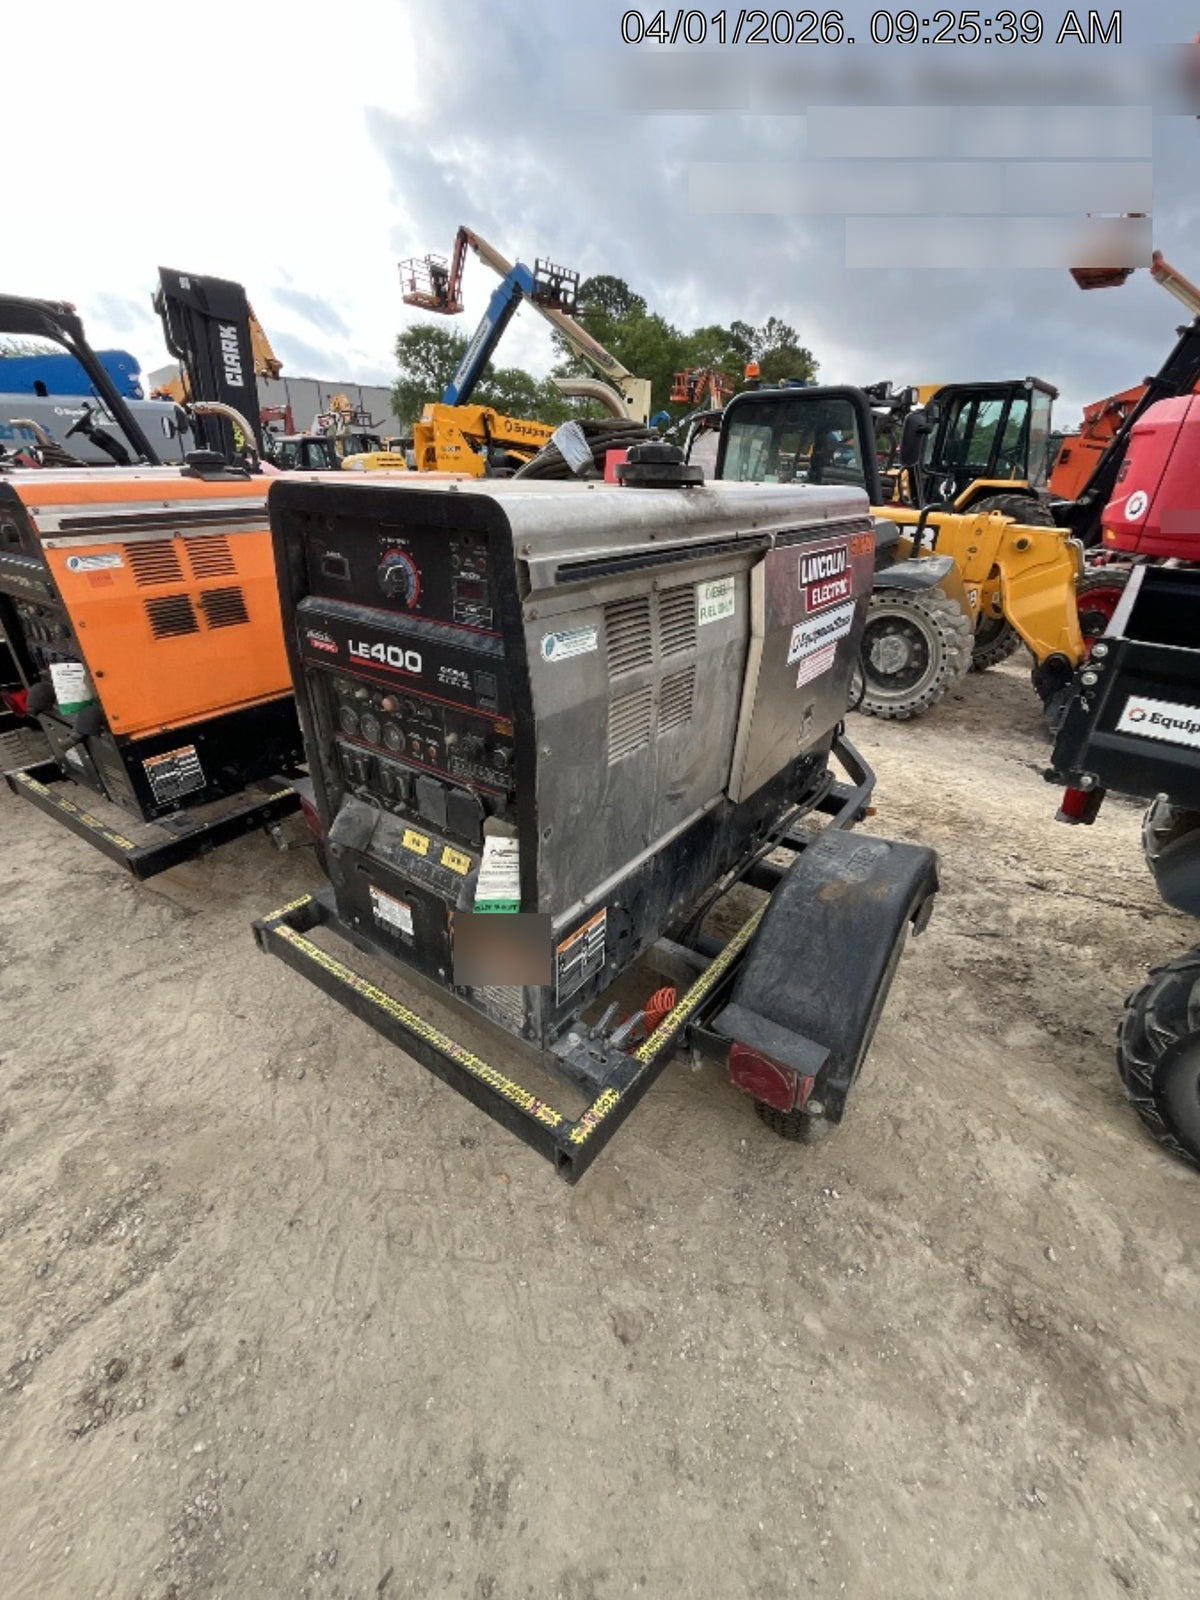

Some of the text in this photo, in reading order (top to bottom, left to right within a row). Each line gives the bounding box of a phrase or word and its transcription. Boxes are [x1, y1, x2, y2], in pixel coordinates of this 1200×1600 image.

[218, 323, 244, 387] CLARK
[801, 550, 846, 584] LINCOLN
[348, 639, 422, 674] LE400
